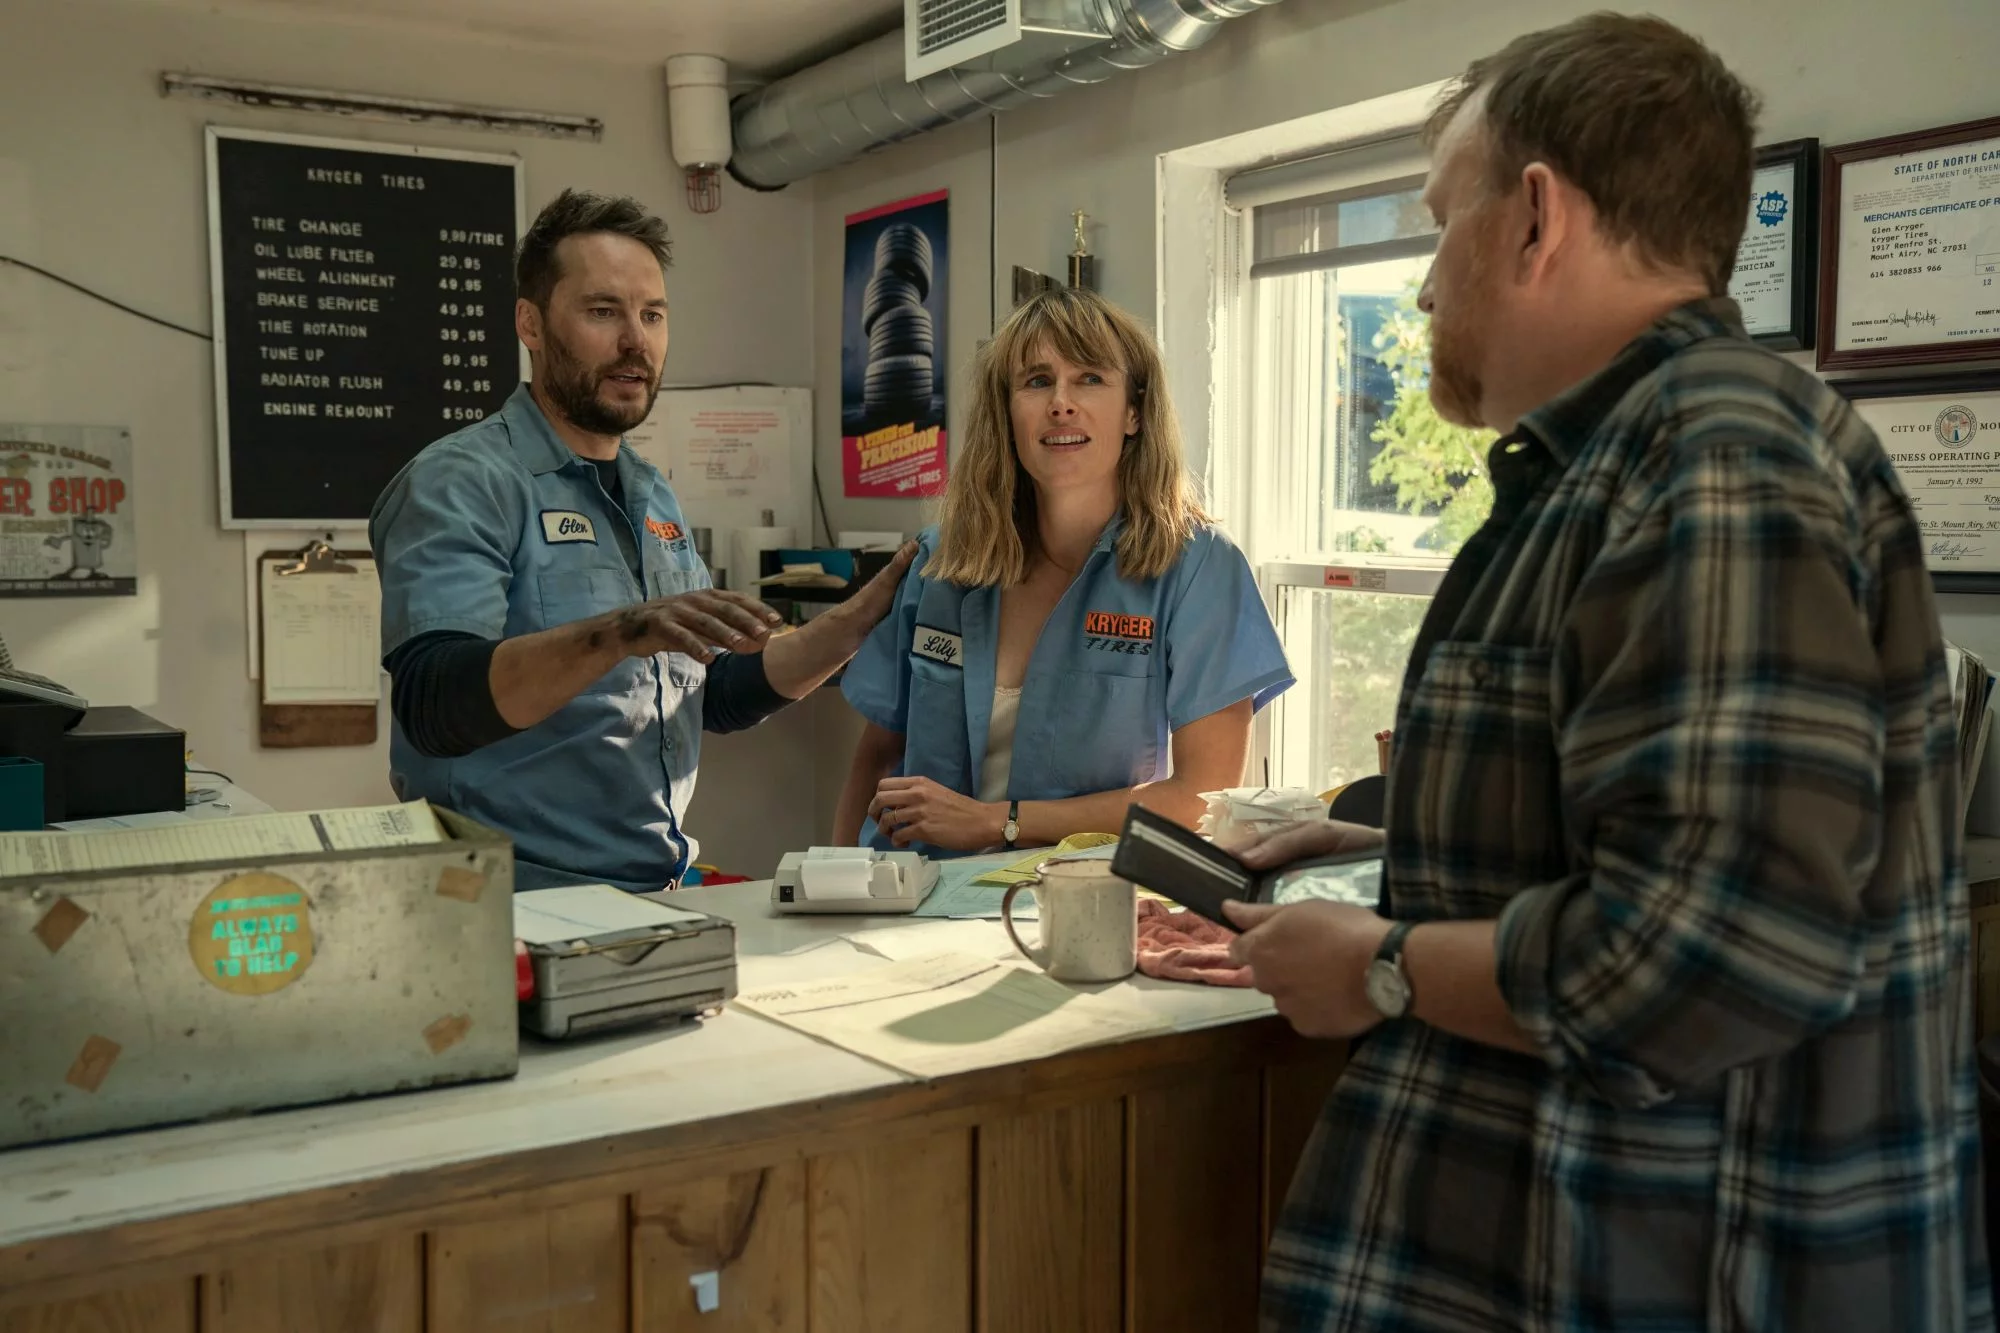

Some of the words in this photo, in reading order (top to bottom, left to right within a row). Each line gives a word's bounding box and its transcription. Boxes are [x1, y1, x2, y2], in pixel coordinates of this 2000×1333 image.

[1894, 162, 1923, 175] STATE
[1927, 159, 1939, 170] OF
[1942, 153, 1977, 168] NORTH
[1911, 169, 1960, 183] DEPARTMENT
[1962, 167, 1971, 176] OF
[1974, 163, 2000, 174] REVEN
[307, 168, 363, 185] KRYGER
[381, 174, 425, 190] TIRES
[1760, 199, 1784, 212] ASP
[1863, 208, 1917, 223] MERCHANTS
[1919, 200, 1977, 215] CERTIFICATE
[1979, 198, 1992, 207] OF
[252, 216, 285, 232] TIRE
[300, 219, 362, 237] CHANGE
[1872, 226, 1891, 235] Glen
[1894, 222, 1925, 233] Kryger
[1871, 234, 1901, 244] Kryger
[1905, 231, 1929, 239] Tires
[1872, 244, 1890, 252] 1917
[1894, 240, 1924, 250] Renfro
[1928, 238, 1942, 246] St.
[254, 243, 278, 258] OIL
[288, 245, 322, 261] LUBE
[330, 247, 374, 264] FILTER
[440, 254, 481, 270] 29.95
[1870, 253, 1894, 261] Mount
[1898, 250, 1921, 258] Airy,
[1942, 243, 1967, 253] 27031
[1927, 264, 1942, 272] 966
[256, 268, 305, 283] WHEEL
[318, 270, 396, 288] ALIGNMENT
[438, 277, 482, 291] 49.95
[257, 293, 308, 309] BRAKE
[317, 296, 379, 313] SERVICE
[439, 303, 485, 317] 49.95
[259, 320, 292, 334] TIRE
[303, 322, 368, 338] ROTATION
[440, 328, 487, 342] 39.95
[260, 346, 298, 361] TUNE
[305, 349, 325, 361] UP
[442, 353, 488, 367] 99.95
[261, 373, 330, 388] RADIATOR
[340, 376, 383, 390] FLUSH
[443, 379, 491, 392] 49.95
[264, 402, 317, 417] ENGINE
[326, 404, 394, 419] REMOUNT
[442, 407, 483, 420] $500
[1890, 424, 1915, 433] CITY
[1918, 424, 1932, 432] OF
[1887, 453, 1926, 462] SINESS
[1929, 451, 1990, 461] OPERATING
[1927, 477, 1955, 487] January
[1956, 477, 1963, 486] 8,
[1965, 477, 1983, 485] 1992
[48, 476, 125, 515] SHOP
[558, 517, 588, 535] Glen
[1940, 520, 1965, 529] Mount
[1966, 520, 1984, 531] Airy,
[1085, 611, 1154, 641] KRYGER
[923, 634, 958, 662] Lily
[1083, 638, 1154, 656] TIRES
[211, 914, 298, 940] ALWAYS
[214, 957, 242, 977] TO
[246, 951, 299, 976] HELP
